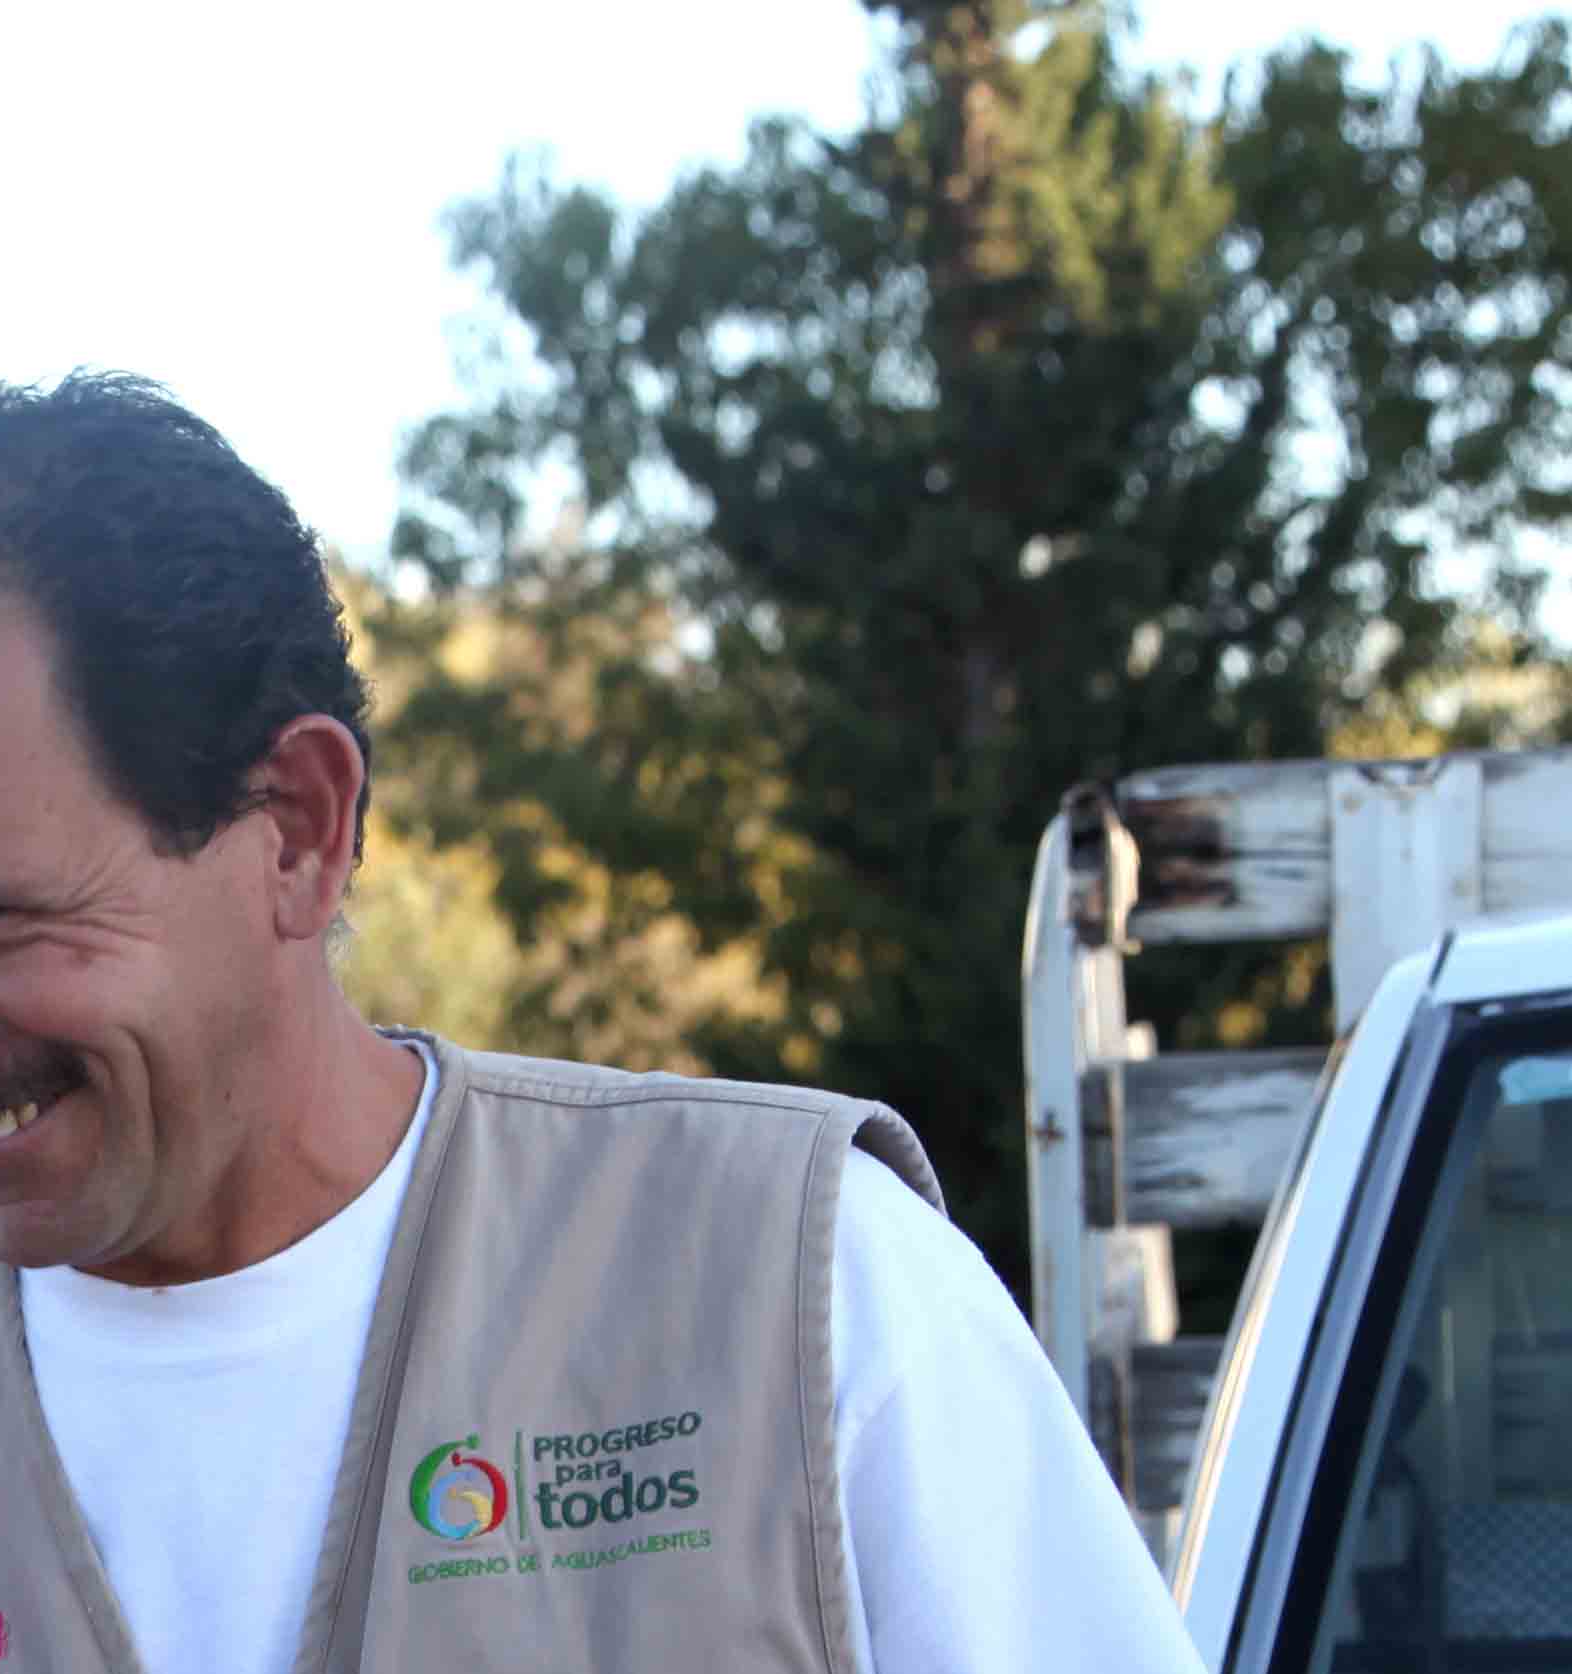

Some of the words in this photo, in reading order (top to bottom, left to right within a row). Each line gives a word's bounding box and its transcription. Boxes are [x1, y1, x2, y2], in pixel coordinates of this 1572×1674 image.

[531, 1409, 704, 1462] PROGRESO
[533, 1468, 701, 1531] todos
[556, 1457, 623, 1487] para
[407, 1556, 509, 1585] GOBIERNO
[518, 1553, 542, 1574] DE
[552, 1528, 714, 1570] AGUASCALIENTES
